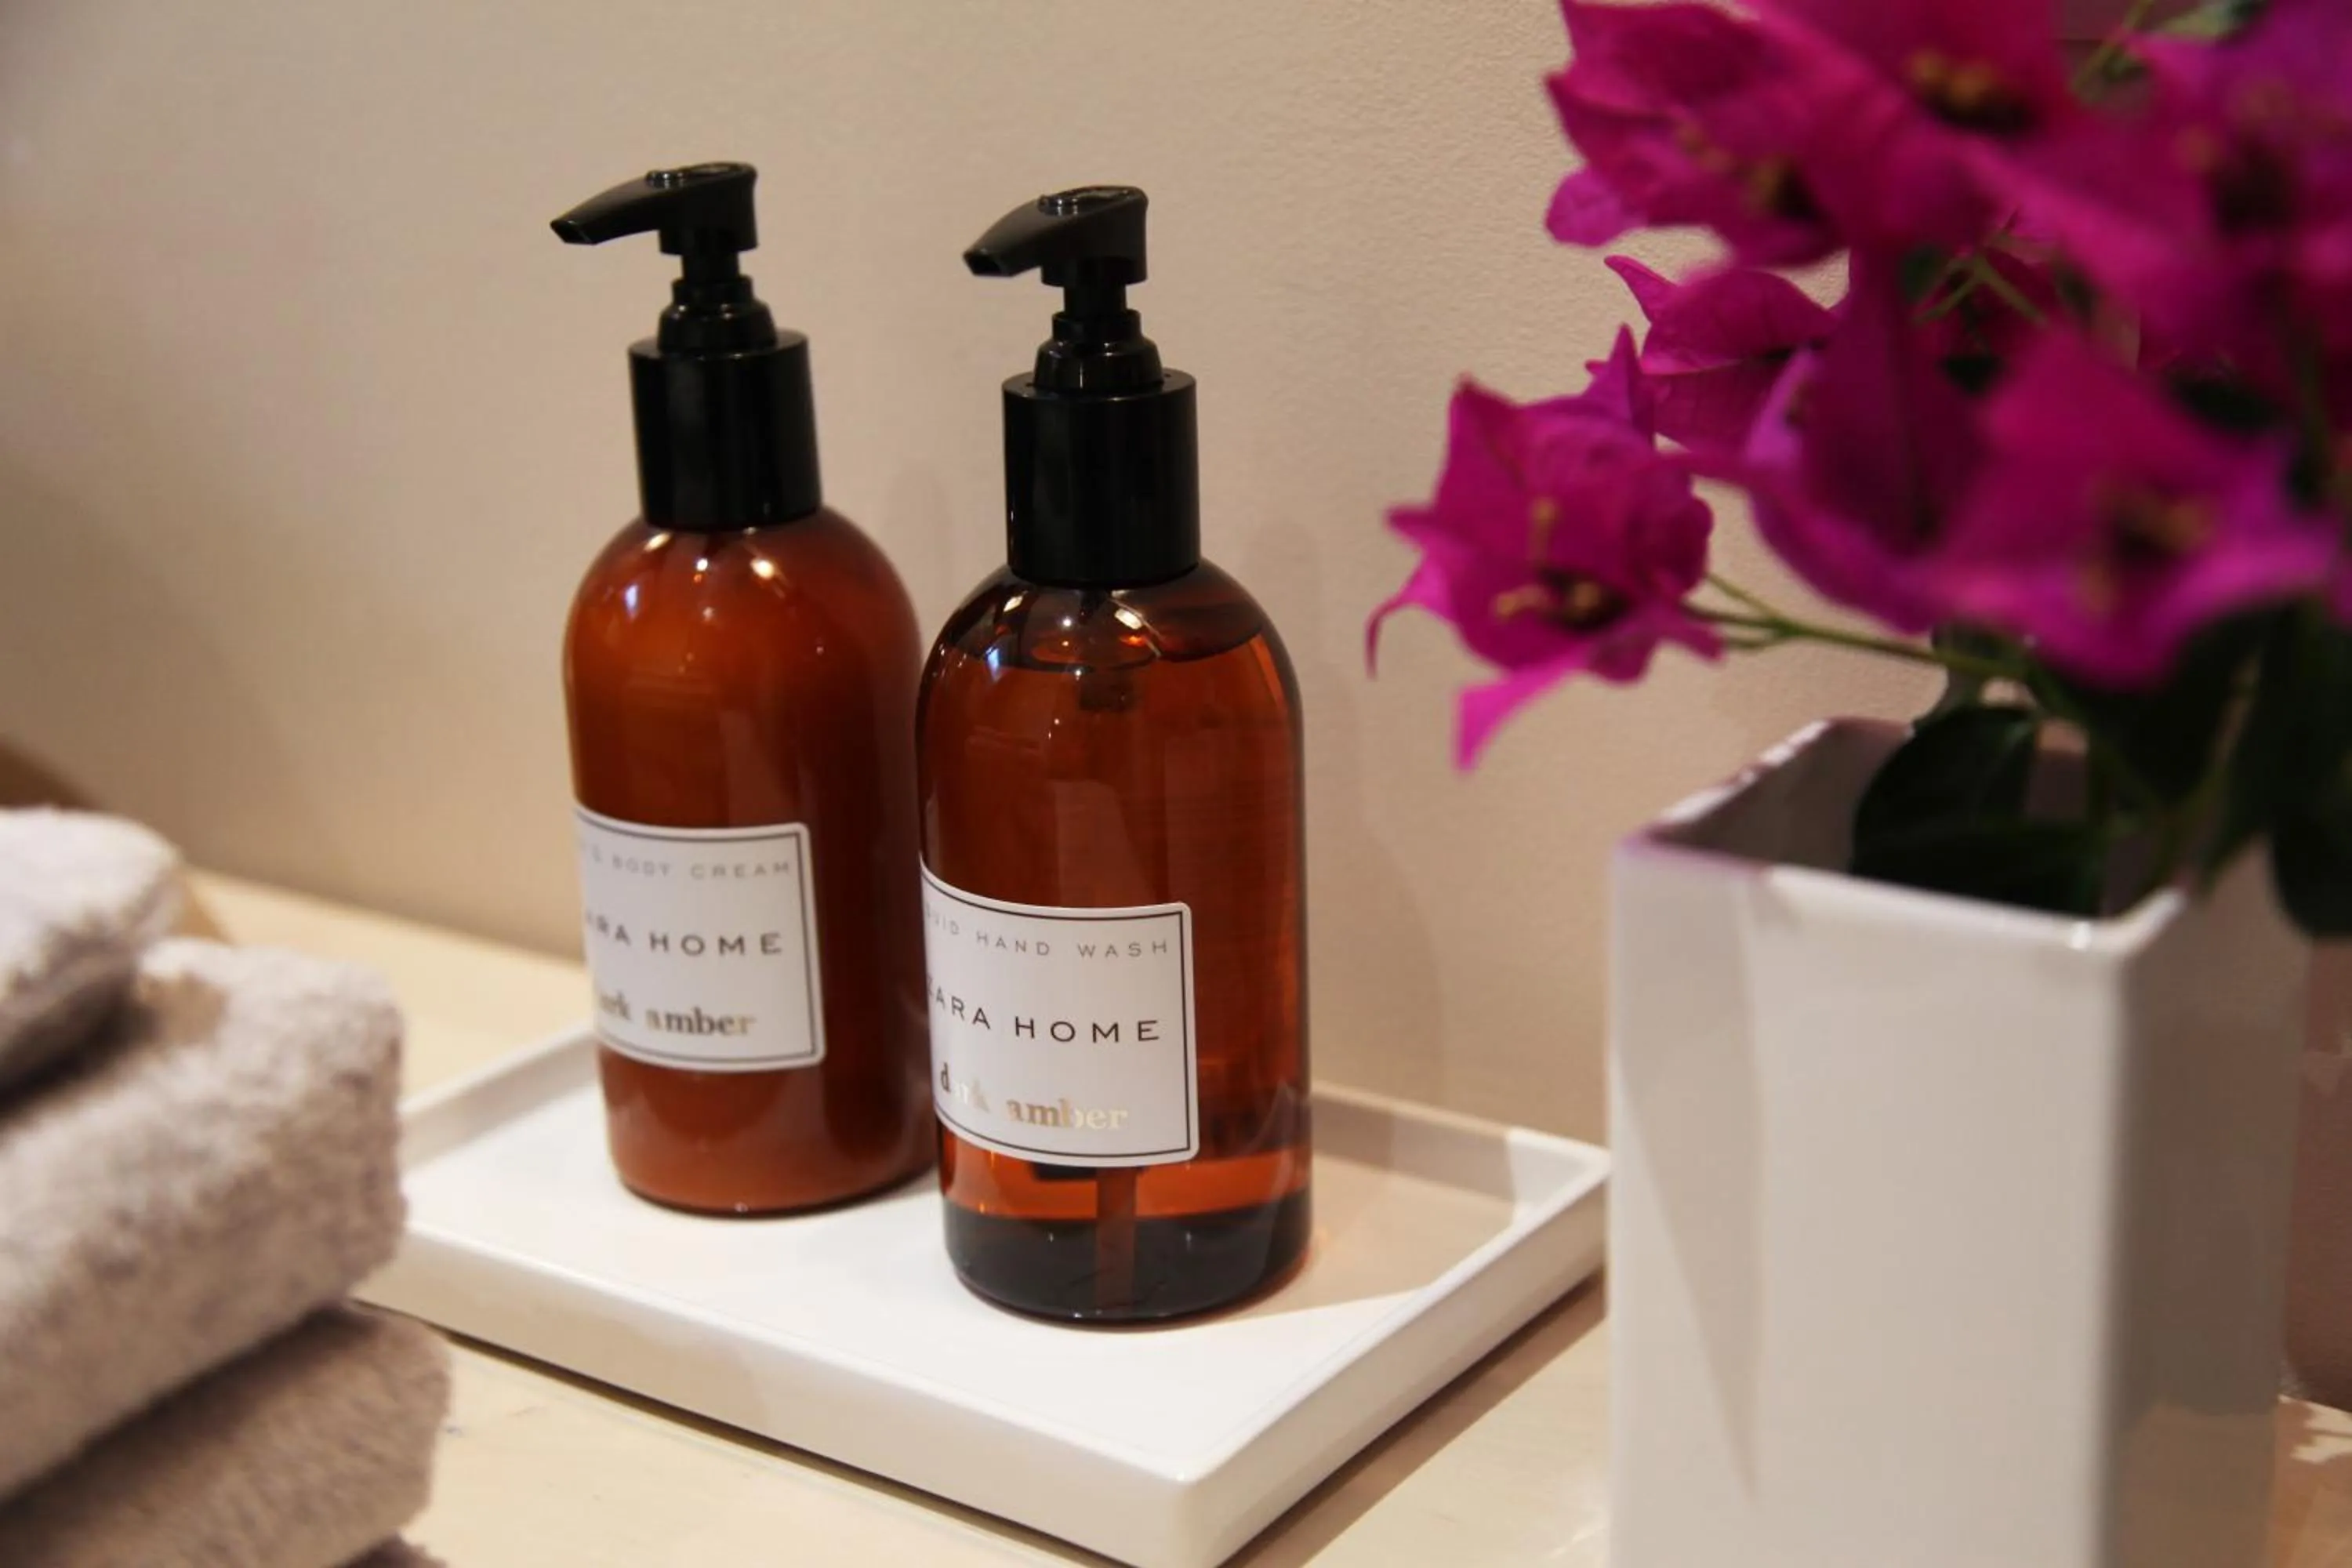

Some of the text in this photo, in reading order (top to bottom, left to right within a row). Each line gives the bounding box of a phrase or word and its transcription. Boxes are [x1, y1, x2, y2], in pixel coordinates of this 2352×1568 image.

[691, 861, 789, 880] CREAM
[649, 932, 782, 956] HOME
[977, 931, 1051, 956] HAND
[1078, 938, 1167, 958] WASH
[645, 1005, 755, 1036] amber
[1015, 1016, 1160, 1043] HOME
[1007, 1098, 1128, 1129] amber
